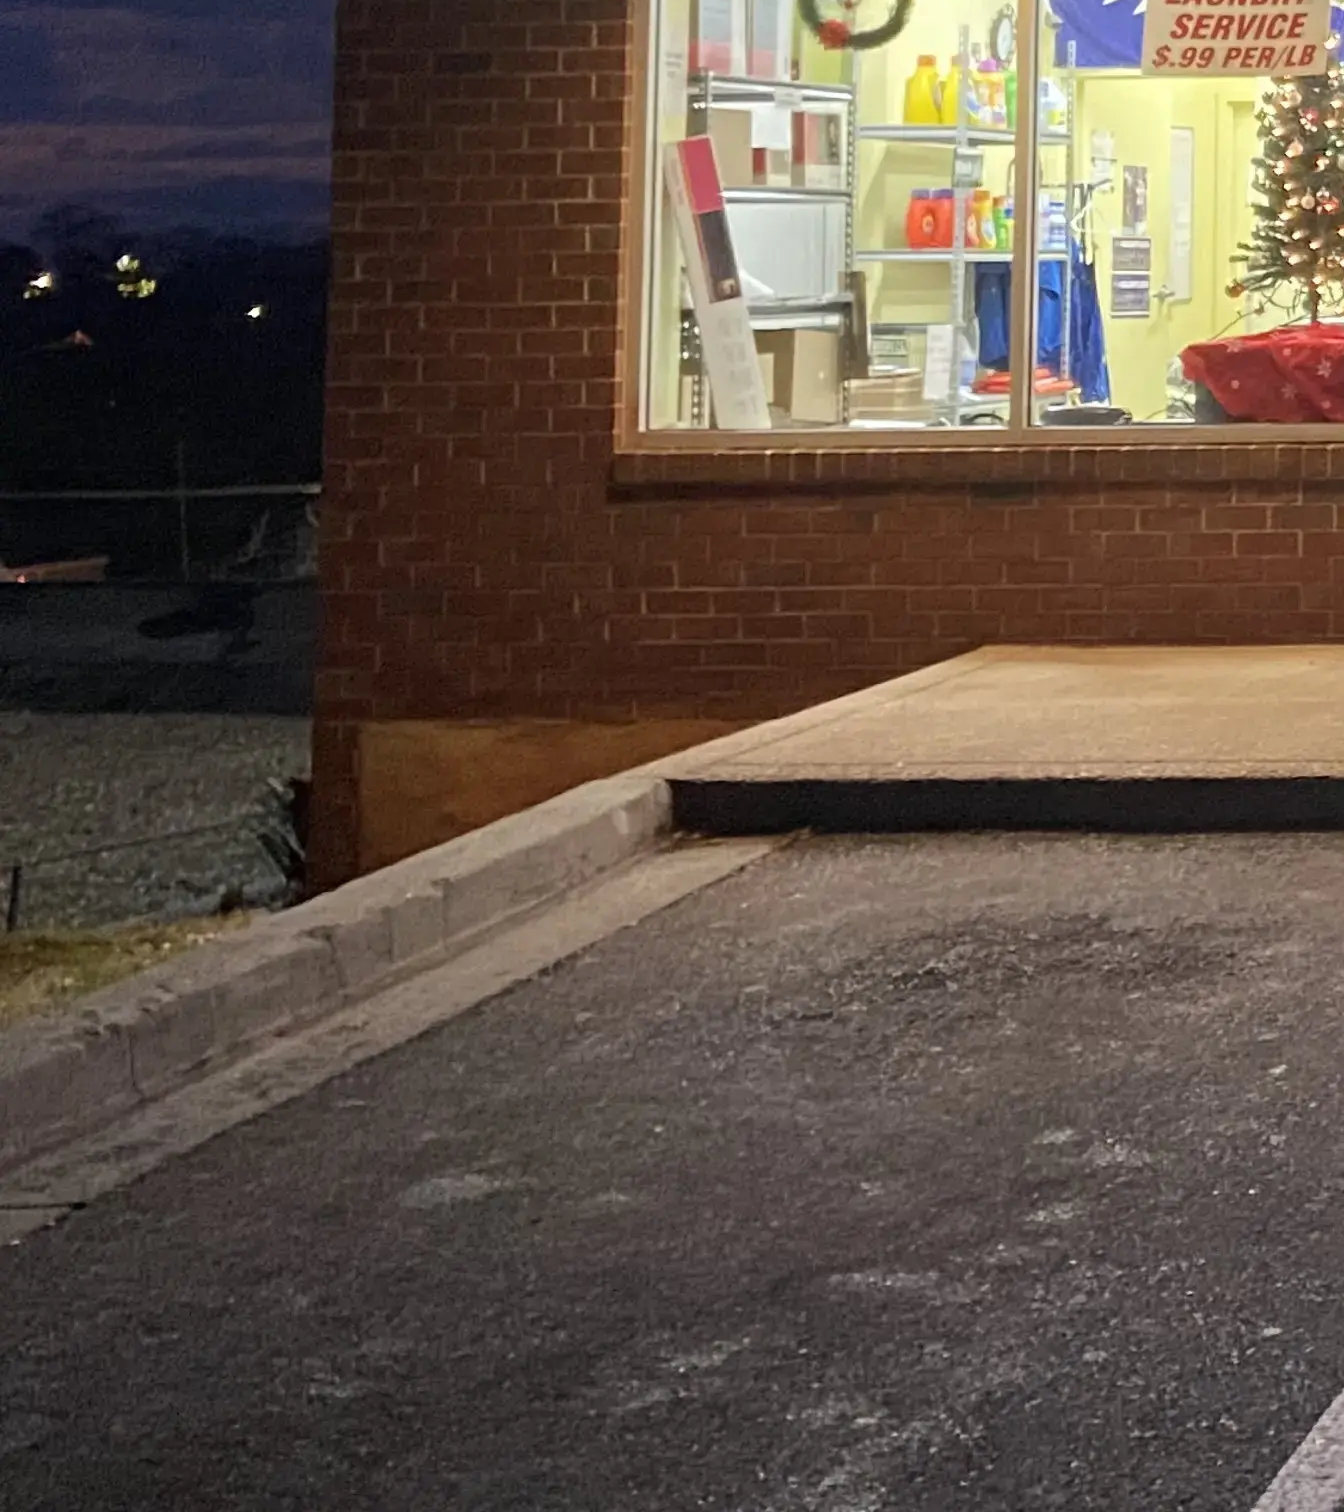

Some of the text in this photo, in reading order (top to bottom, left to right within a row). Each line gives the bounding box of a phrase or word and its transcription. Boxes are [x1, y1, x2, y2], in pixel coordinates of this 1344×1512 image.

[1170, 13, 1309, 41] SERVICE
[1152, 44, 1318, 71] $.99 PER/LB
